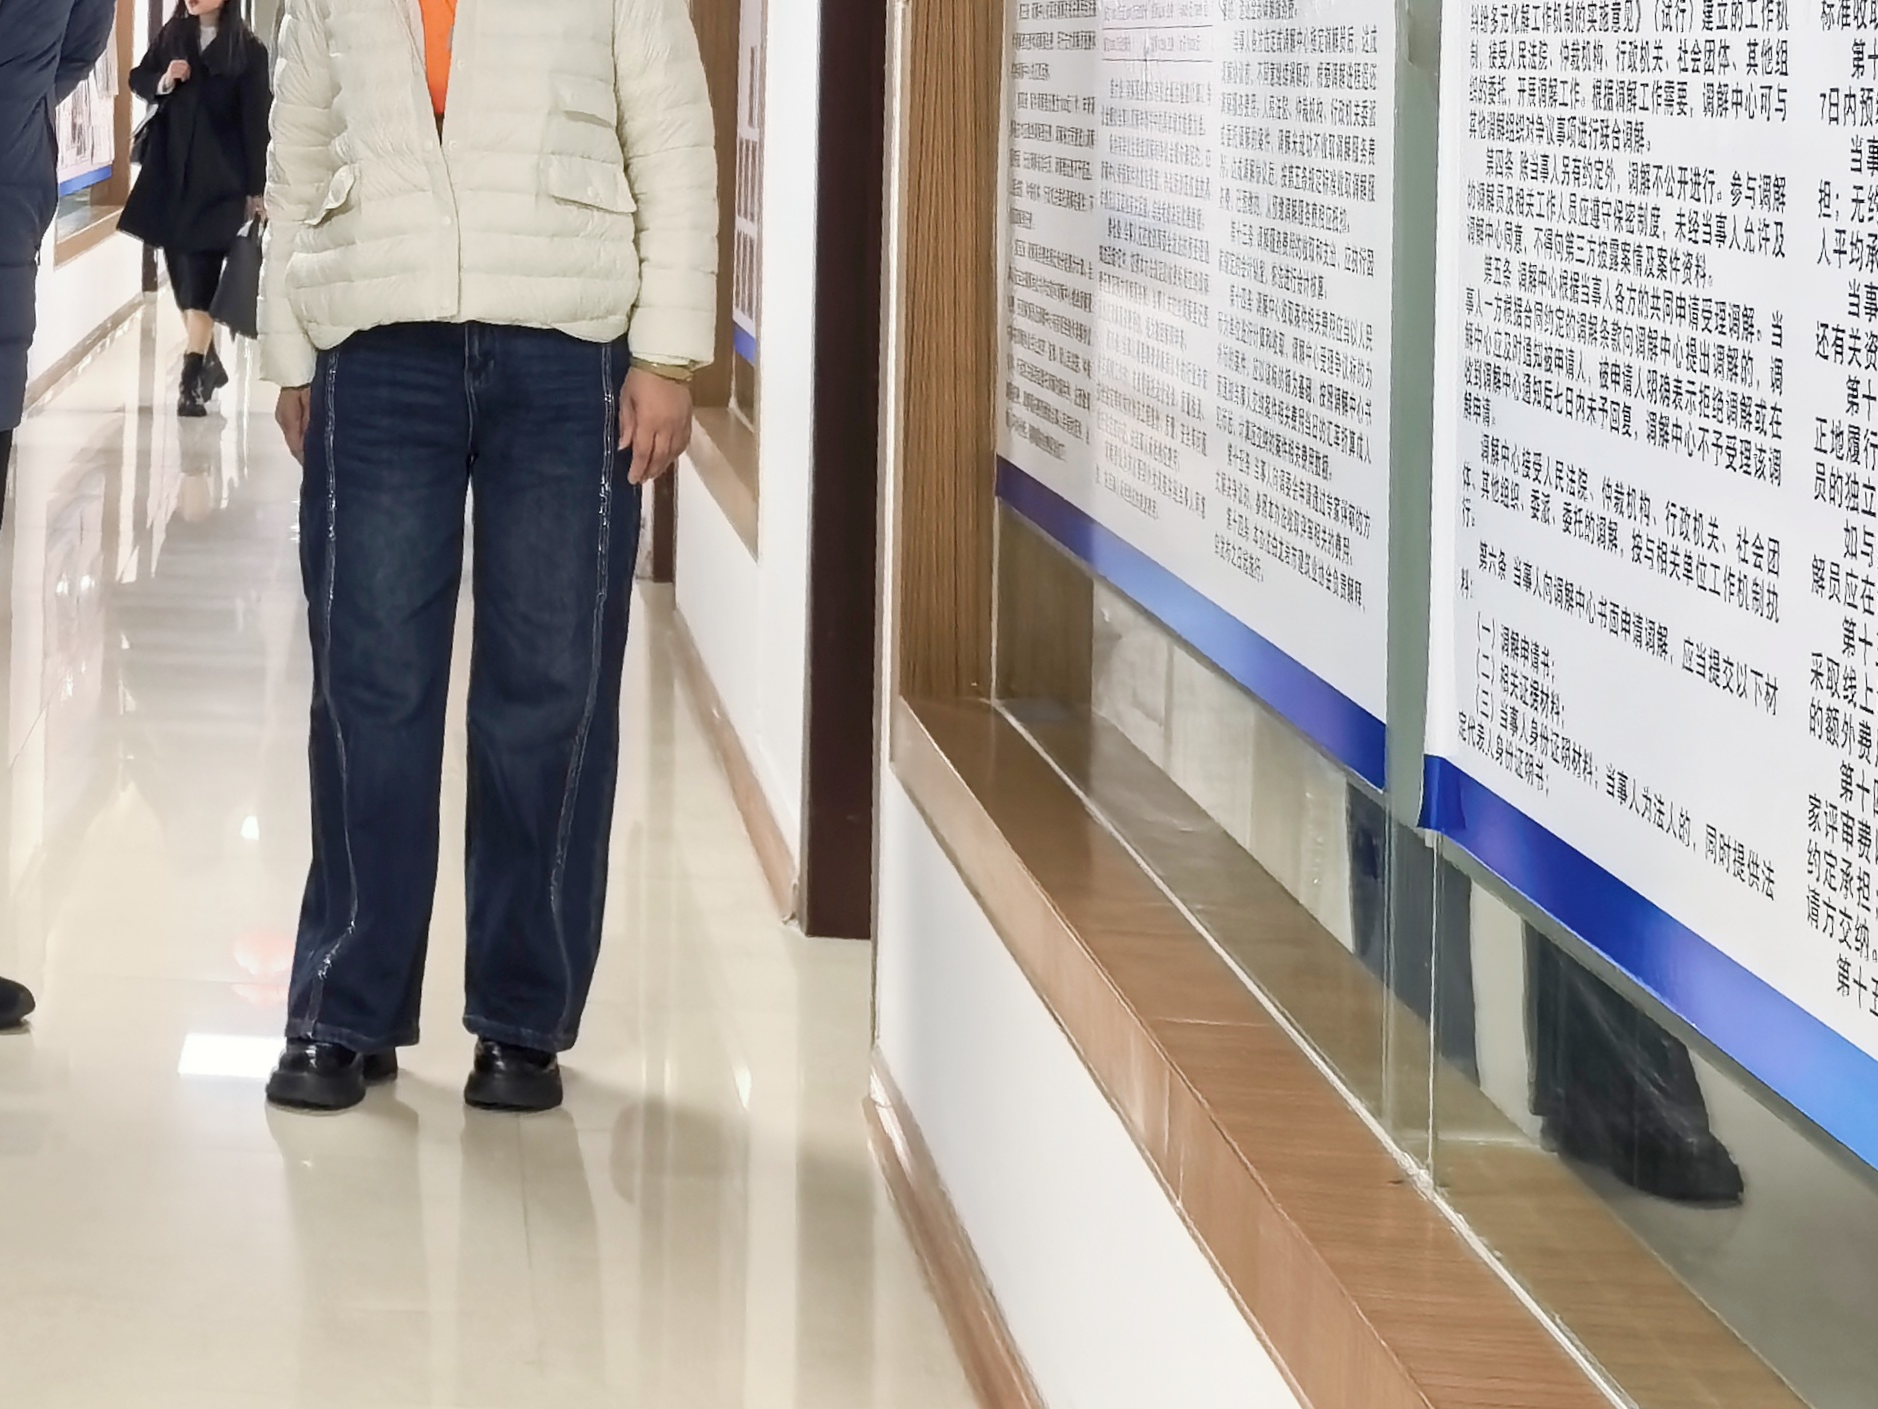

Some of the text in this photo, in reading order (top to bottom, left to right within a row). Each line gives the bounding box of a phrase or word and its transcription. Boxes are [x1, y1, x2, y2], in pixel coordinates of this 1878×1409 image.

[1819, 86, 1878, 126] 7日内预
[1842, 616, 1878, 667] 第十
[1811, 652, 1878, 715] 采取线上
[1809, 697, 1878, 767] 的额外费
[1808, 794, 1878, 865] 家评审费
[1806, 839, 1878, 919] 约定承担
